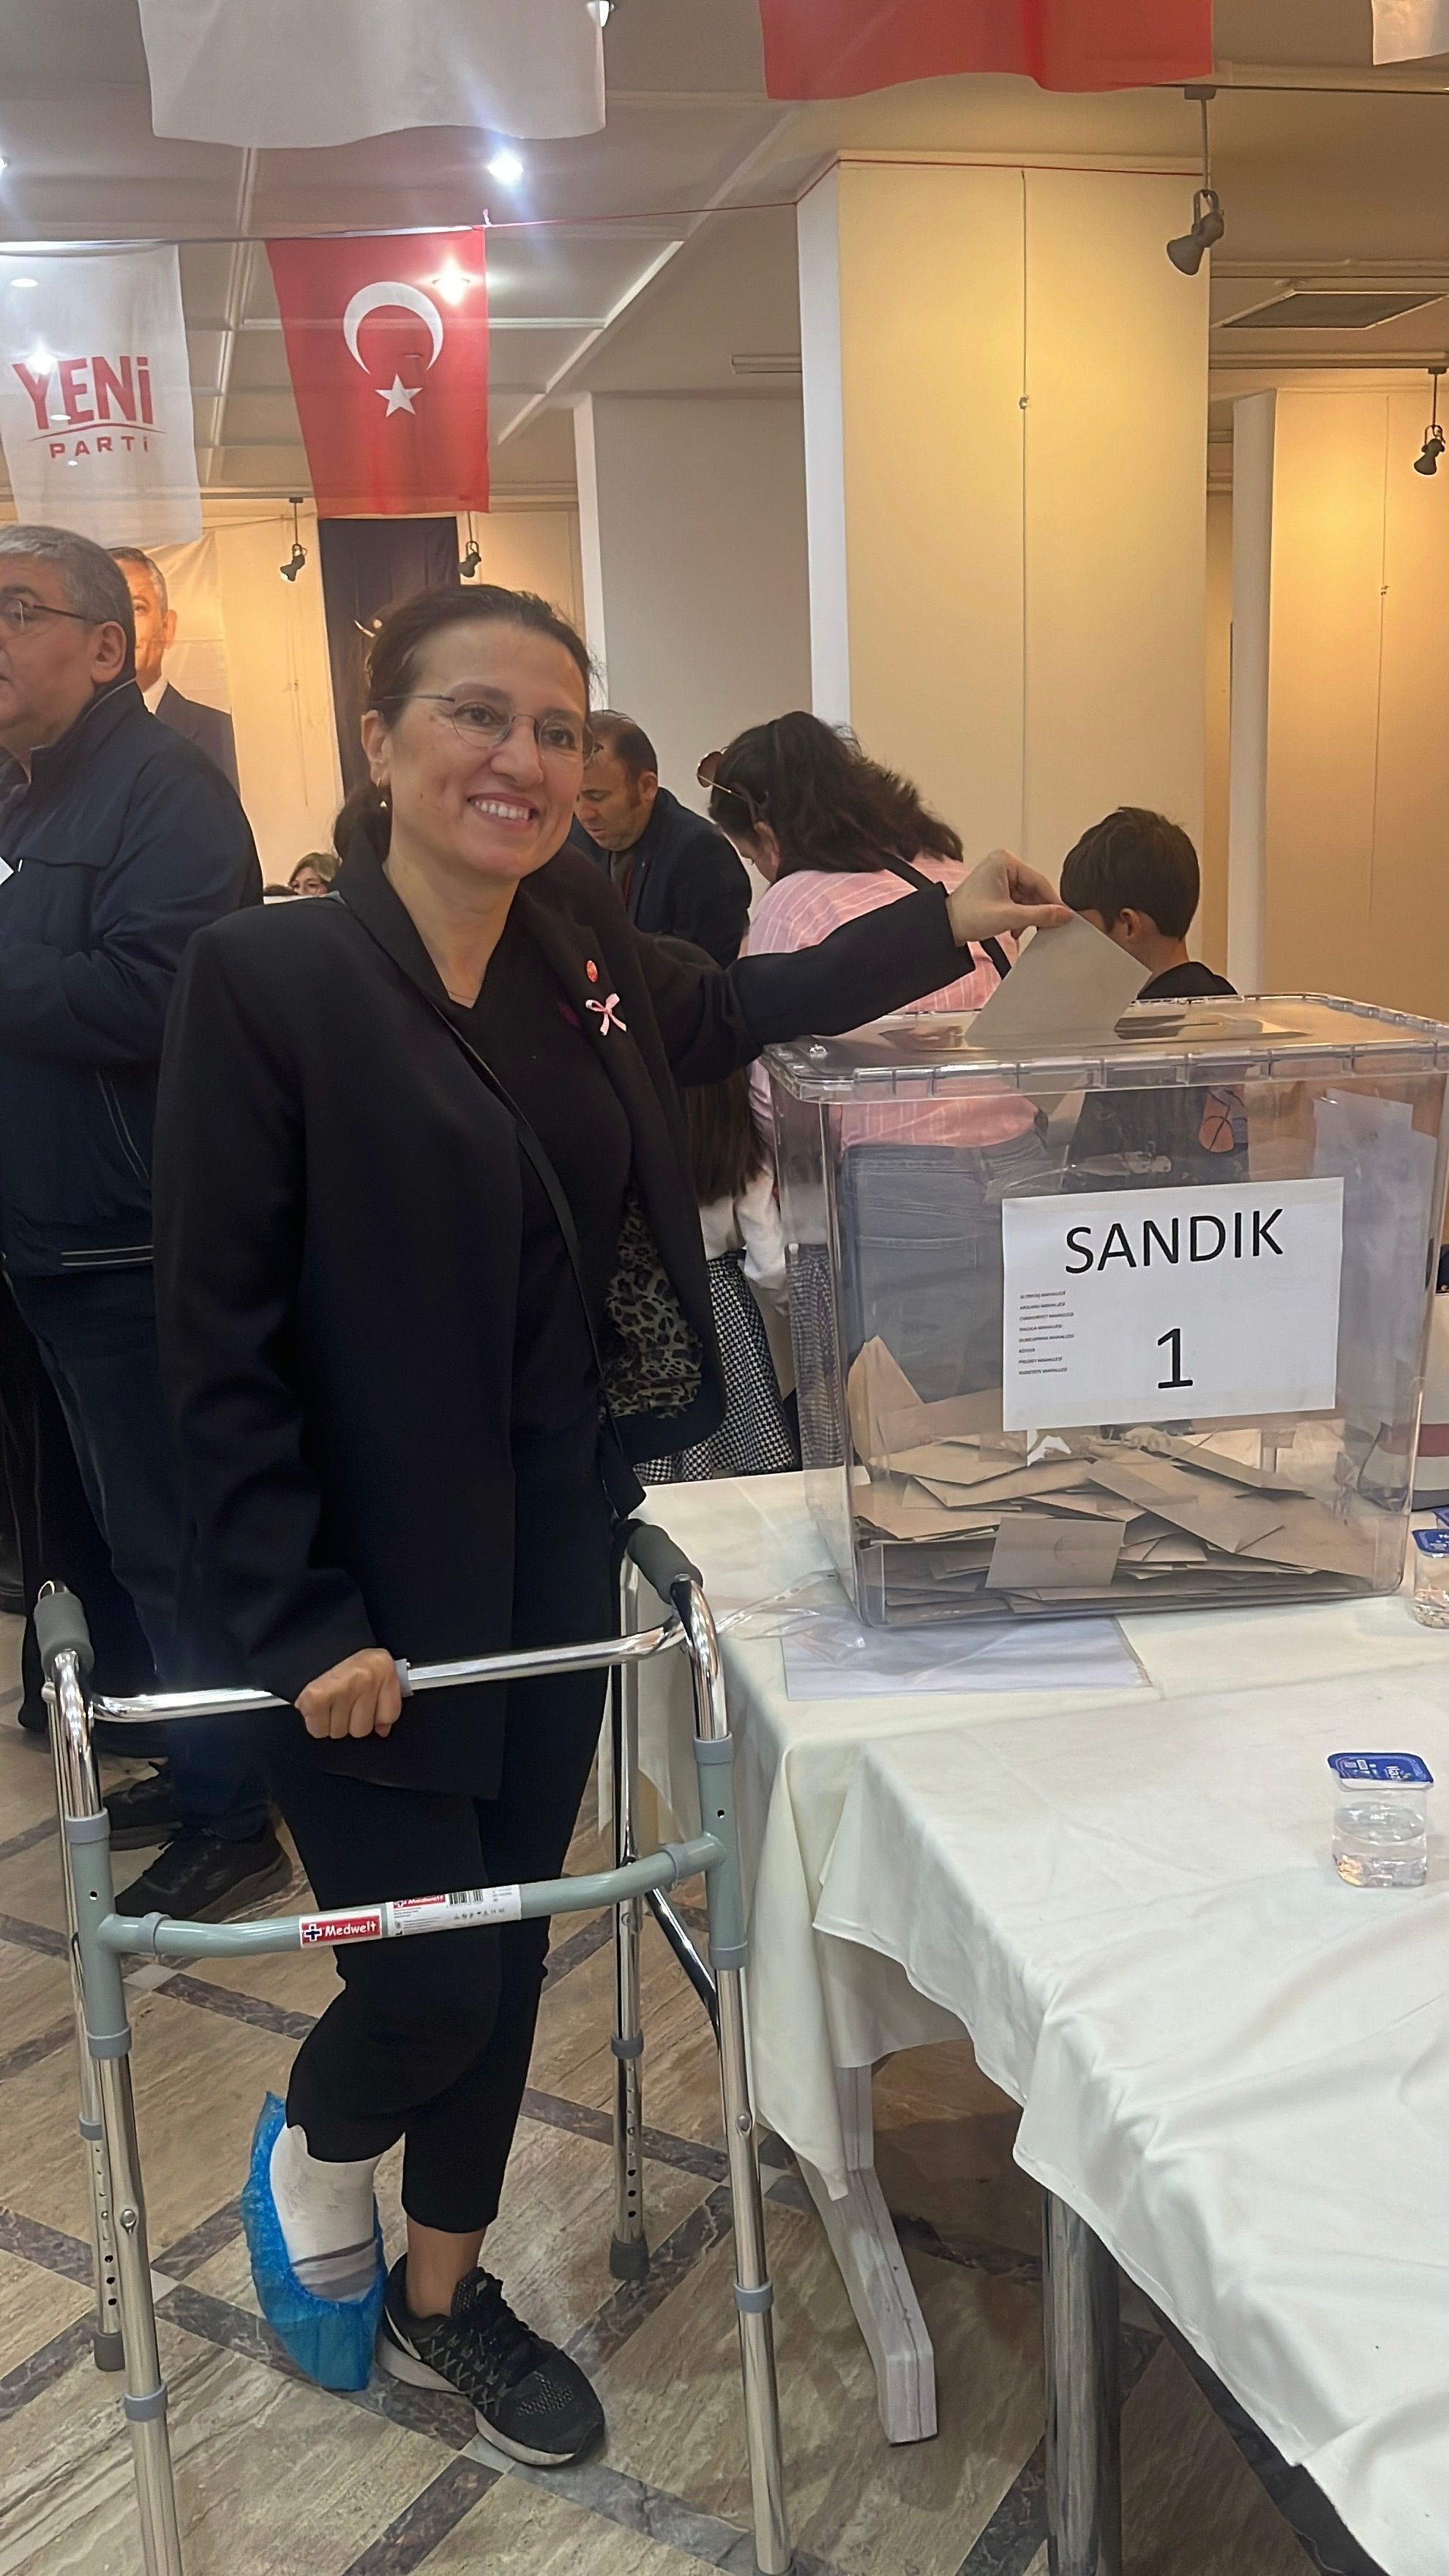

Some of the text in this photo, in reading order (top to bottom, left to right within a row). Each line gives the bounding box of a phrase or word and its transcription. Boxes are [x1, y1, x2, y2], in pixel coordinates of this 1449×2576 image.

[1066, 1208, 1283, 1273] SANDIK
[1158, 1328, 1193, 1388] 1
[325, 1920, 377, 1937] Medwelt
